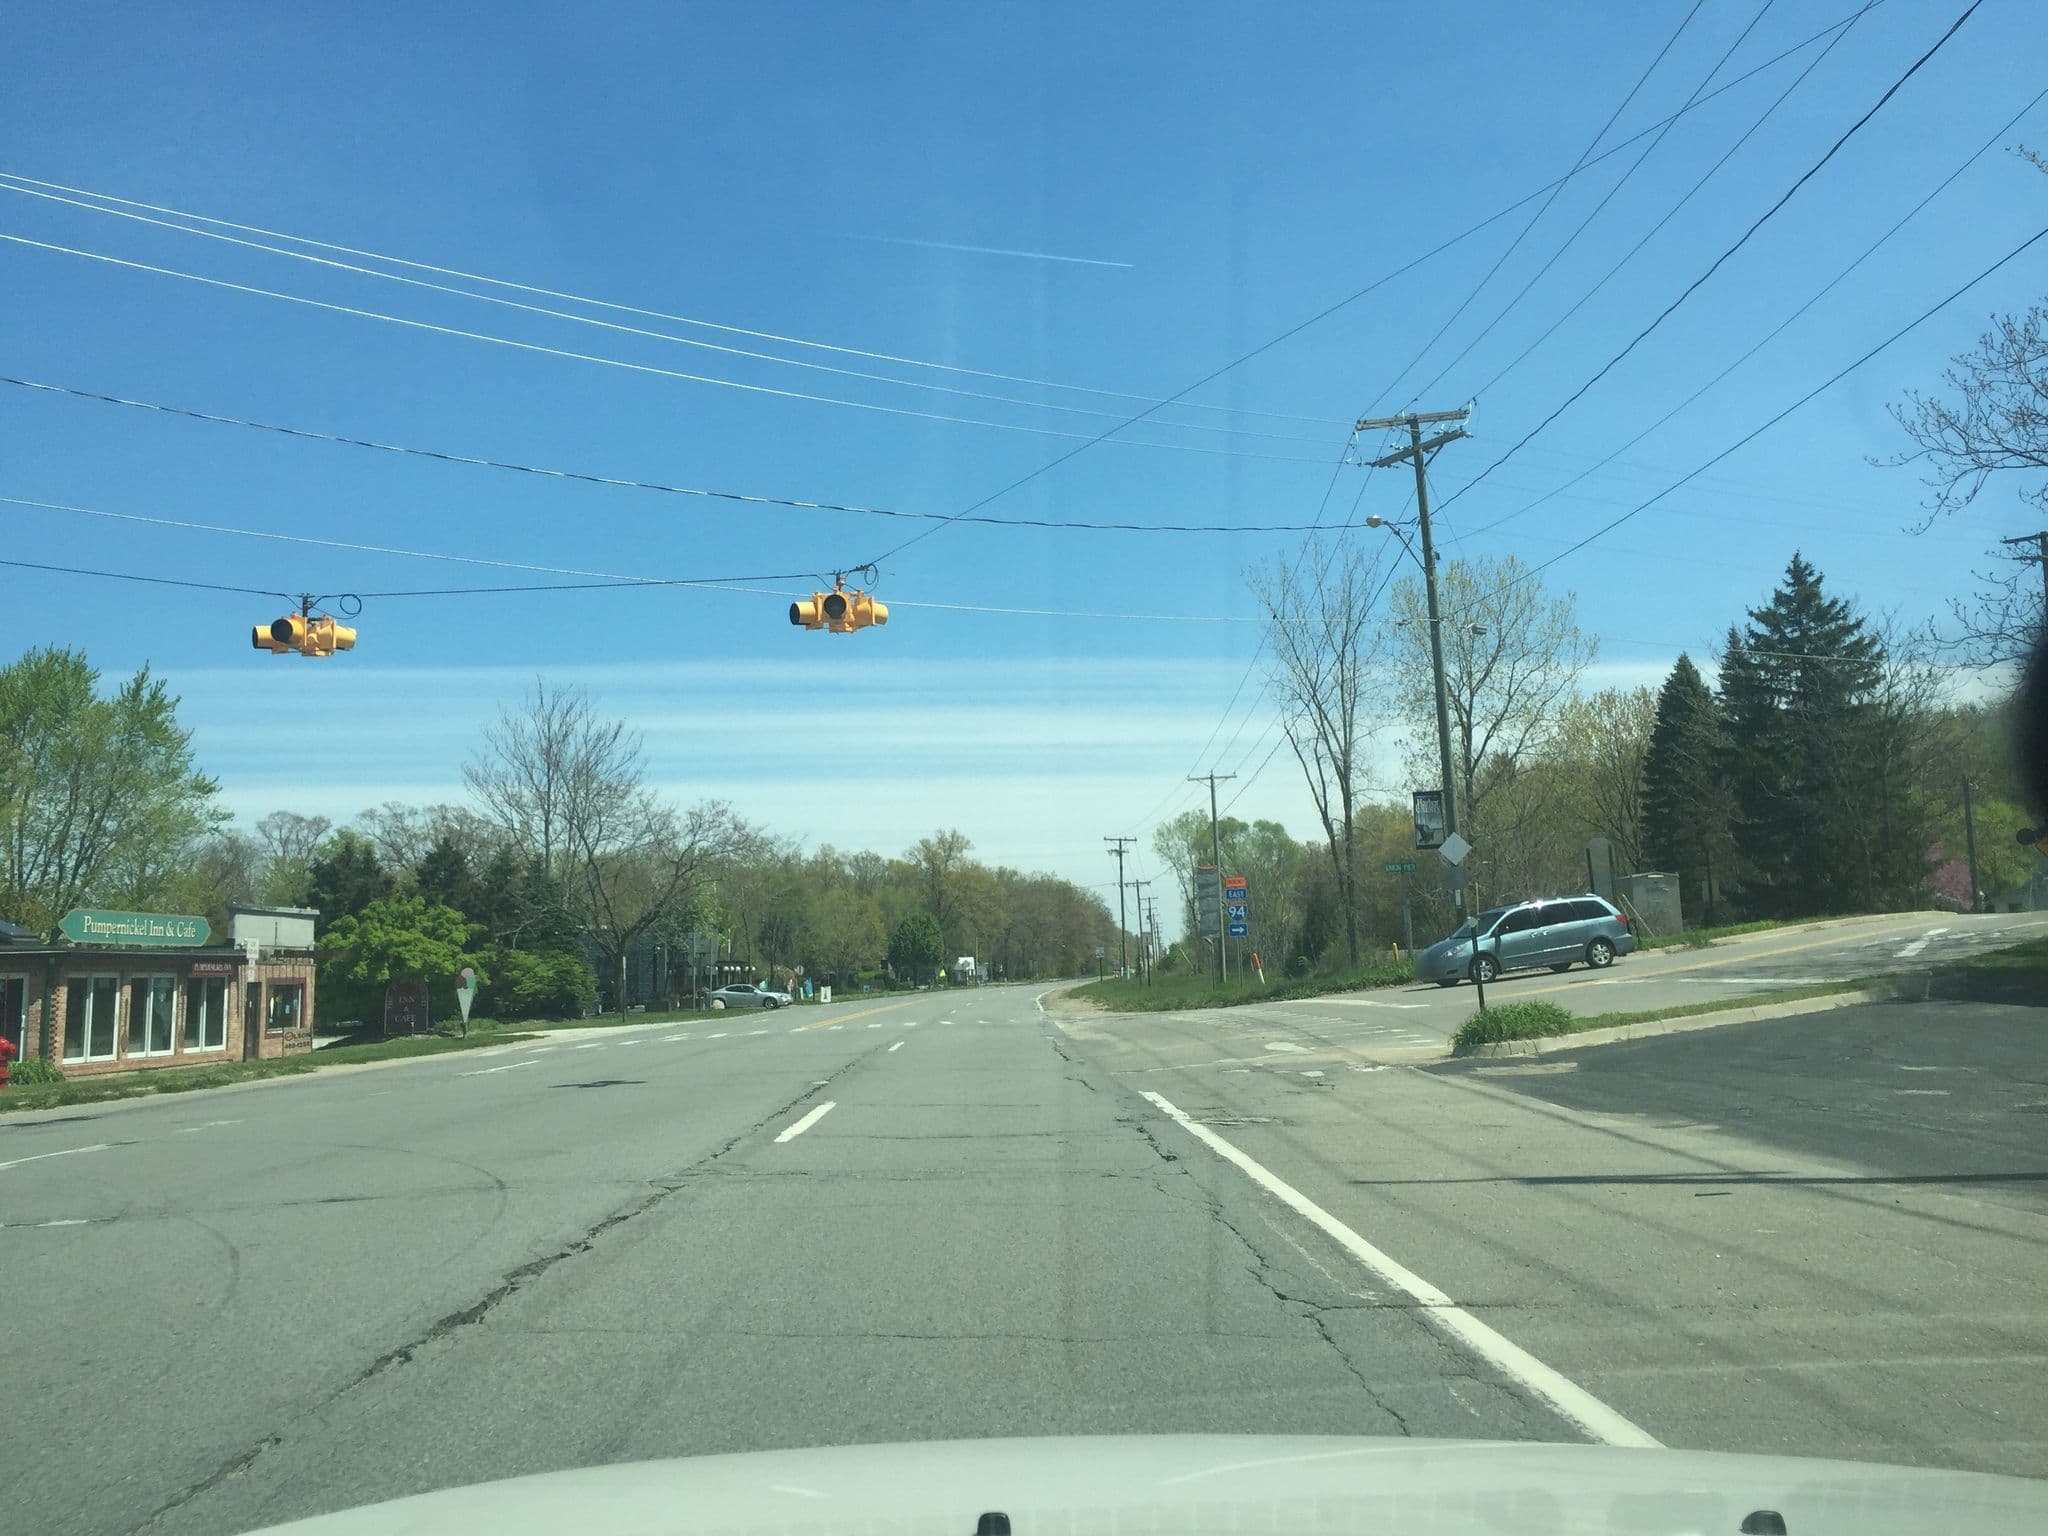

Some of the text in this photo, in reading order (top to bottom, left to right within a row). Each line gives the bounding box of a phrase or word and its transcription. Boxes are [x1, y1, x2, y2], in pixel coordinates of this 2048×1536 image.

[1228, 890, 1245, 898] EAST
[1228, 906, 1245, 918] 94
[83, 915, 196, 938] Pumpernickel Inn & Cafe
